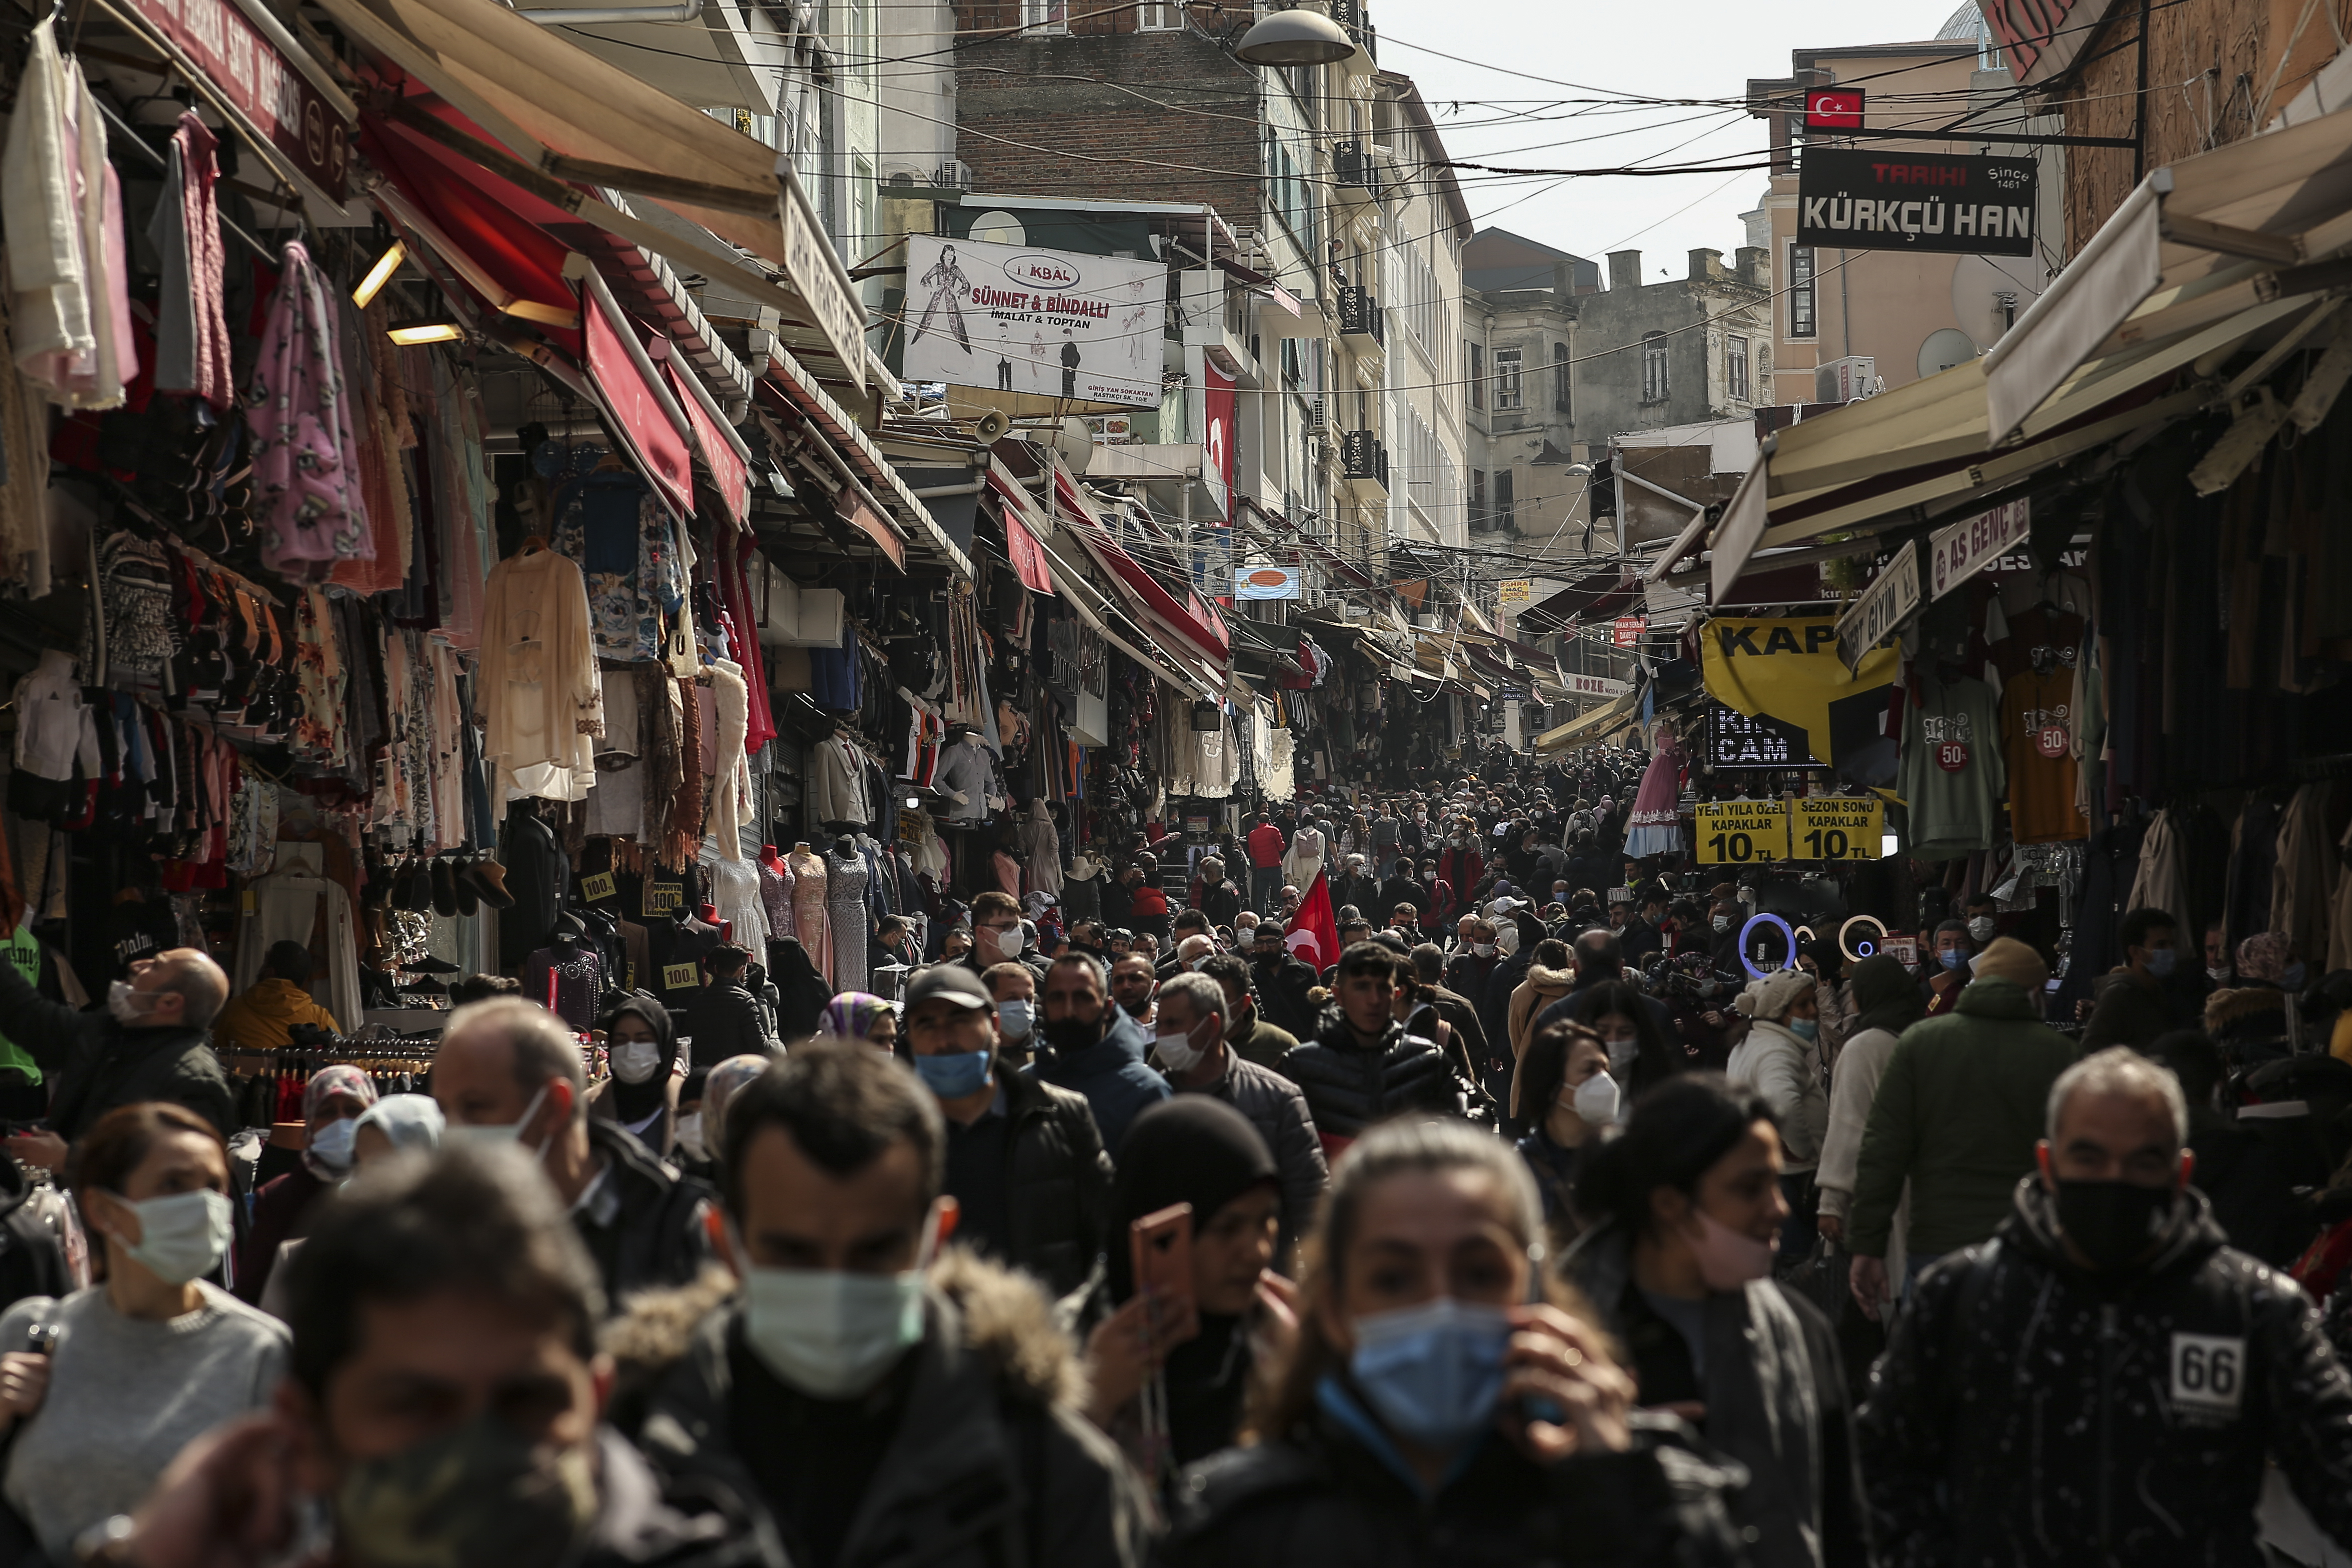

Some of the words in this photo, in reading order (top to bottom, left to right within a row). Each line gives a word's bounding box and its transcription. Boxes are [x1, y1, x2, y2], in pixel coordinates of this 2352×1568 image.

[1871, 163, 1966, 186] TARİHİ
[1988, 166, 2029, 181] Since
[1997, 180, 2020, 189] 1461
[1803, 191, 1945, 241] KÜRKÇÜ
[1954, 203, 2030, 238] HAN
[971, 286, 1029, 310] SÜNNET
[1030, 295, 1042, 311] &
[1047, 294, 1110, 319] BİNDALLI
[990, 310, 1031, 323] İMALAT
[1034, 315, 1043, 324] &
[1047, 316, 1091, 329] TOPTAN
[1088, 385, 1105, 393] GİRİŞ
[1120, 388, 1154, 397] SOKAKTAN
[1093, 392, 1122, 400] RASTIKÇI
[1950, 532, 1967, 573] AS
[1971, 503, 2009, 557] GENÇ
[1868, 581, 1897, 642] GİYİM
[1616, 621, 1629, 629] NİKAH
[1576, 677, 1604, 693] ROZE
[2043, 730, 2062, 748] 50
[1718, 738, 1788, 761] CAM
[1942, 746, 1961, 763] 50
[1697, 805, 1724, 817] YENİ
[1728, 805, 1753, 816] YILA
[1757, 802, 1786, 815] ÖZEL
[1801, 802, 1840, 813] SEZON
[1711, 818, 1772, 831] KAPAKLAR
[1808, 816, 1868, 827] KAPAKLAR
[1708, 833, 1753, 862] 10
[1755, 850, 1776, 861] TL
[1804, 829, 1848, 859] 10
[1851, 848, 1872, 859] TL
[585, 878, 608, 896] 100
[654, 893, 675, 909] 100
[667, 968, 691, 985] 100
[2181, 1346, 2235, 1395] 66
